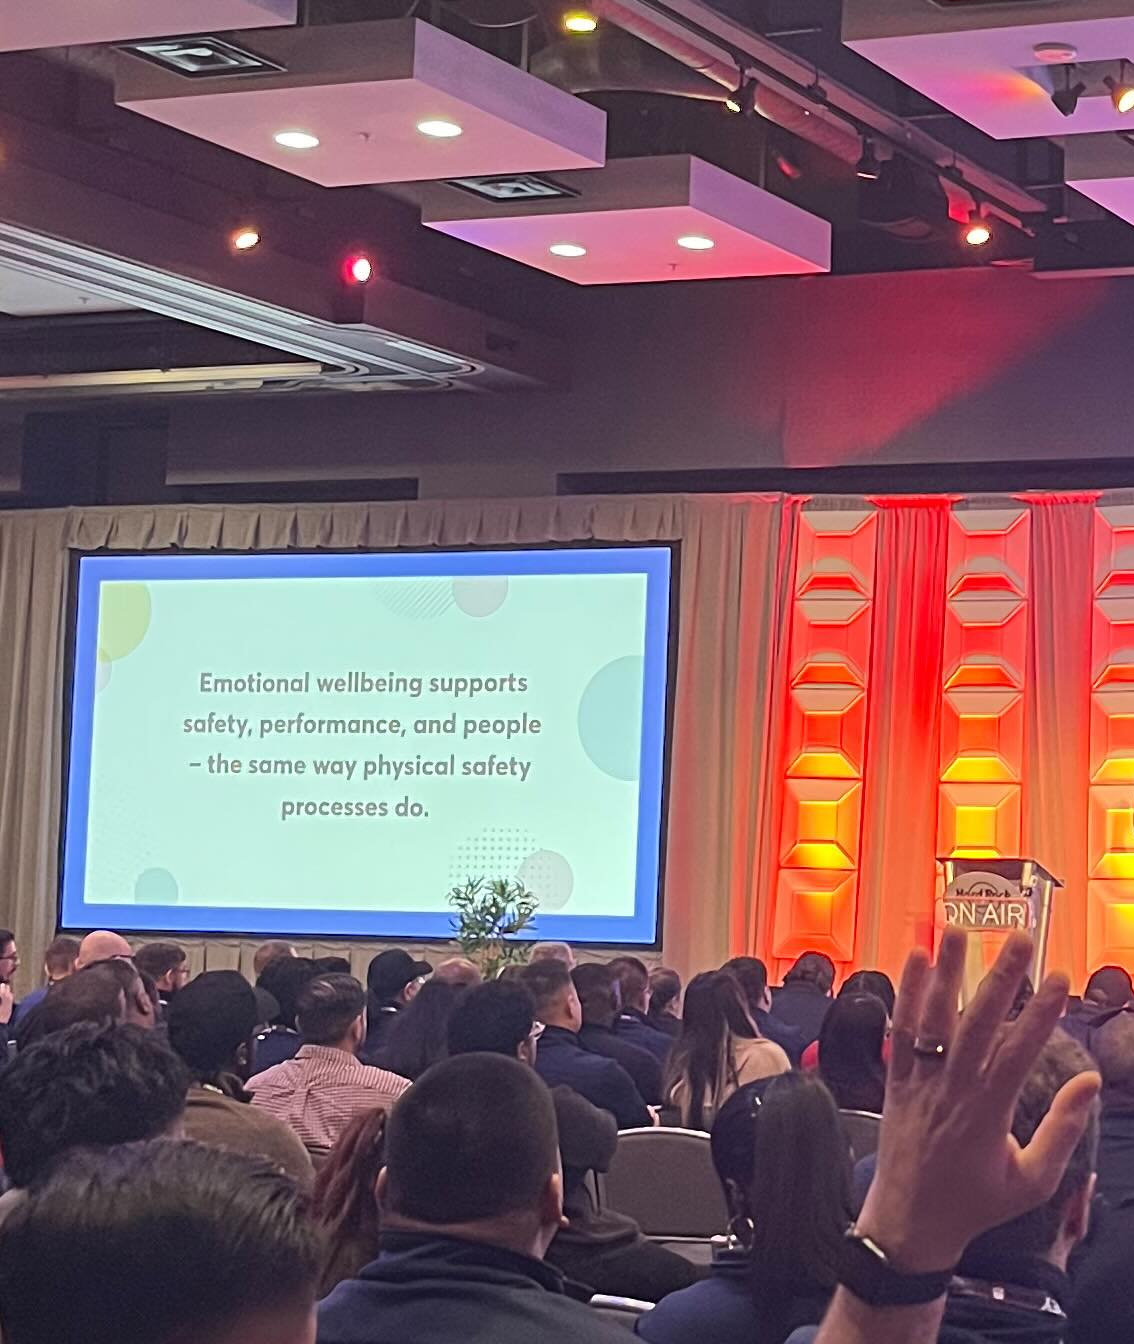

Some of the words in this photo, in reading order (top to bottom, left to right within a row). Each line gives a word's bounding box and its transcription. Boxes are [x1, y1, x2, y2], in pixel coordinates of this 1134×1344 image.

[200, 671, 310, 694] Emotional
[316, 671, 423, 698] wellbeing
[428, 672, 528, 699] supports
[183, 711, 253, 740] safety,
[259, 711, 407, 740] performance,
[413, 712, 457, 735] and
[463, 712, 542, 740] people
[207, 752, 243, 775] the
[248, 759, 307, 775] same
[312, 759, 358, 781] way
[363, 752, 455, 782] physical
[461, 753, 532, 783] safety
[281, 800, 389, 822] processes
[394, 795, 429, 818] do.
[945, 902, 976, 926] ON
[982, 902, 1025, 927] AIR
